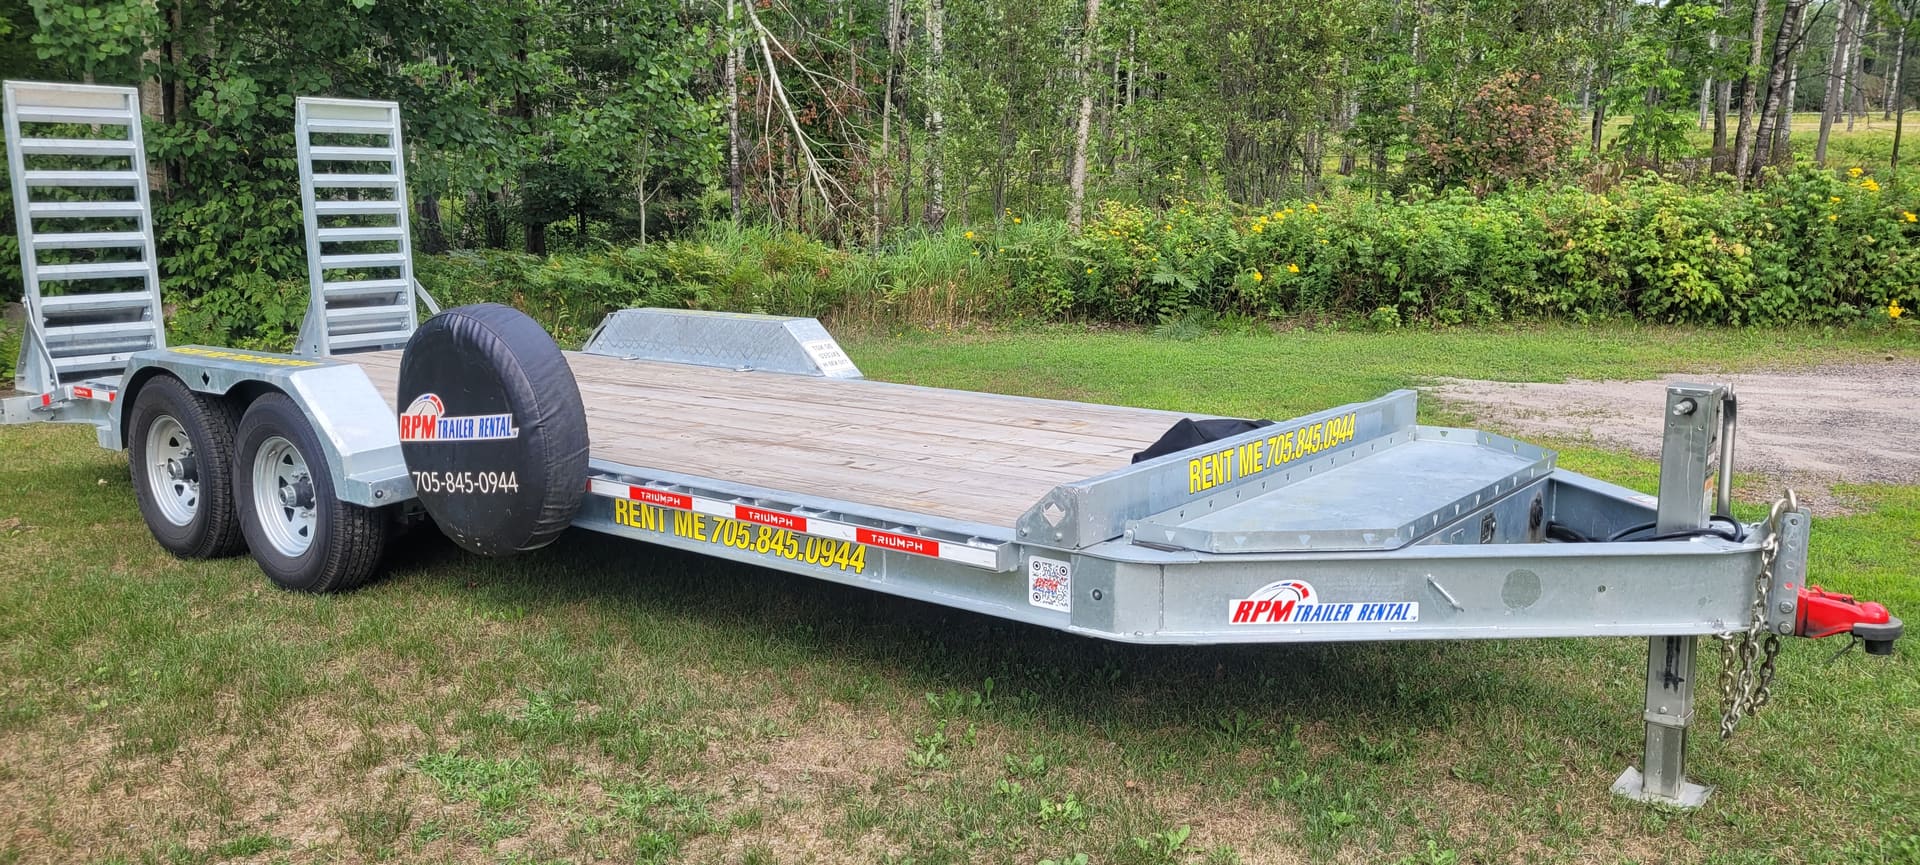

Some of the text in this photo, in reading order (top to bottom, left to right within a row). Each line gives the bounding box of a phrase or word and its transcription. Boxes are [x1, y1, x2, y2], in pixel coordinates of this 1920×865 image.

[400, 414, 512, 439] RPM TRAILER RENTAL
[1188, 411, 1357, 495] RENT ME 705.845.0944
[412, 471, 519, 494] 705-845-0944
[640, 491, 681, 506] TRIUMPH
[748, 511, 794, 527] TRIUMPH
[614, 497, 867, 575] RENT ME 705.845.0944
[871, 534, 924, 552] TRIUMPH
[1232, 600, 1411, 623] RPM TRAILER RENTAL
